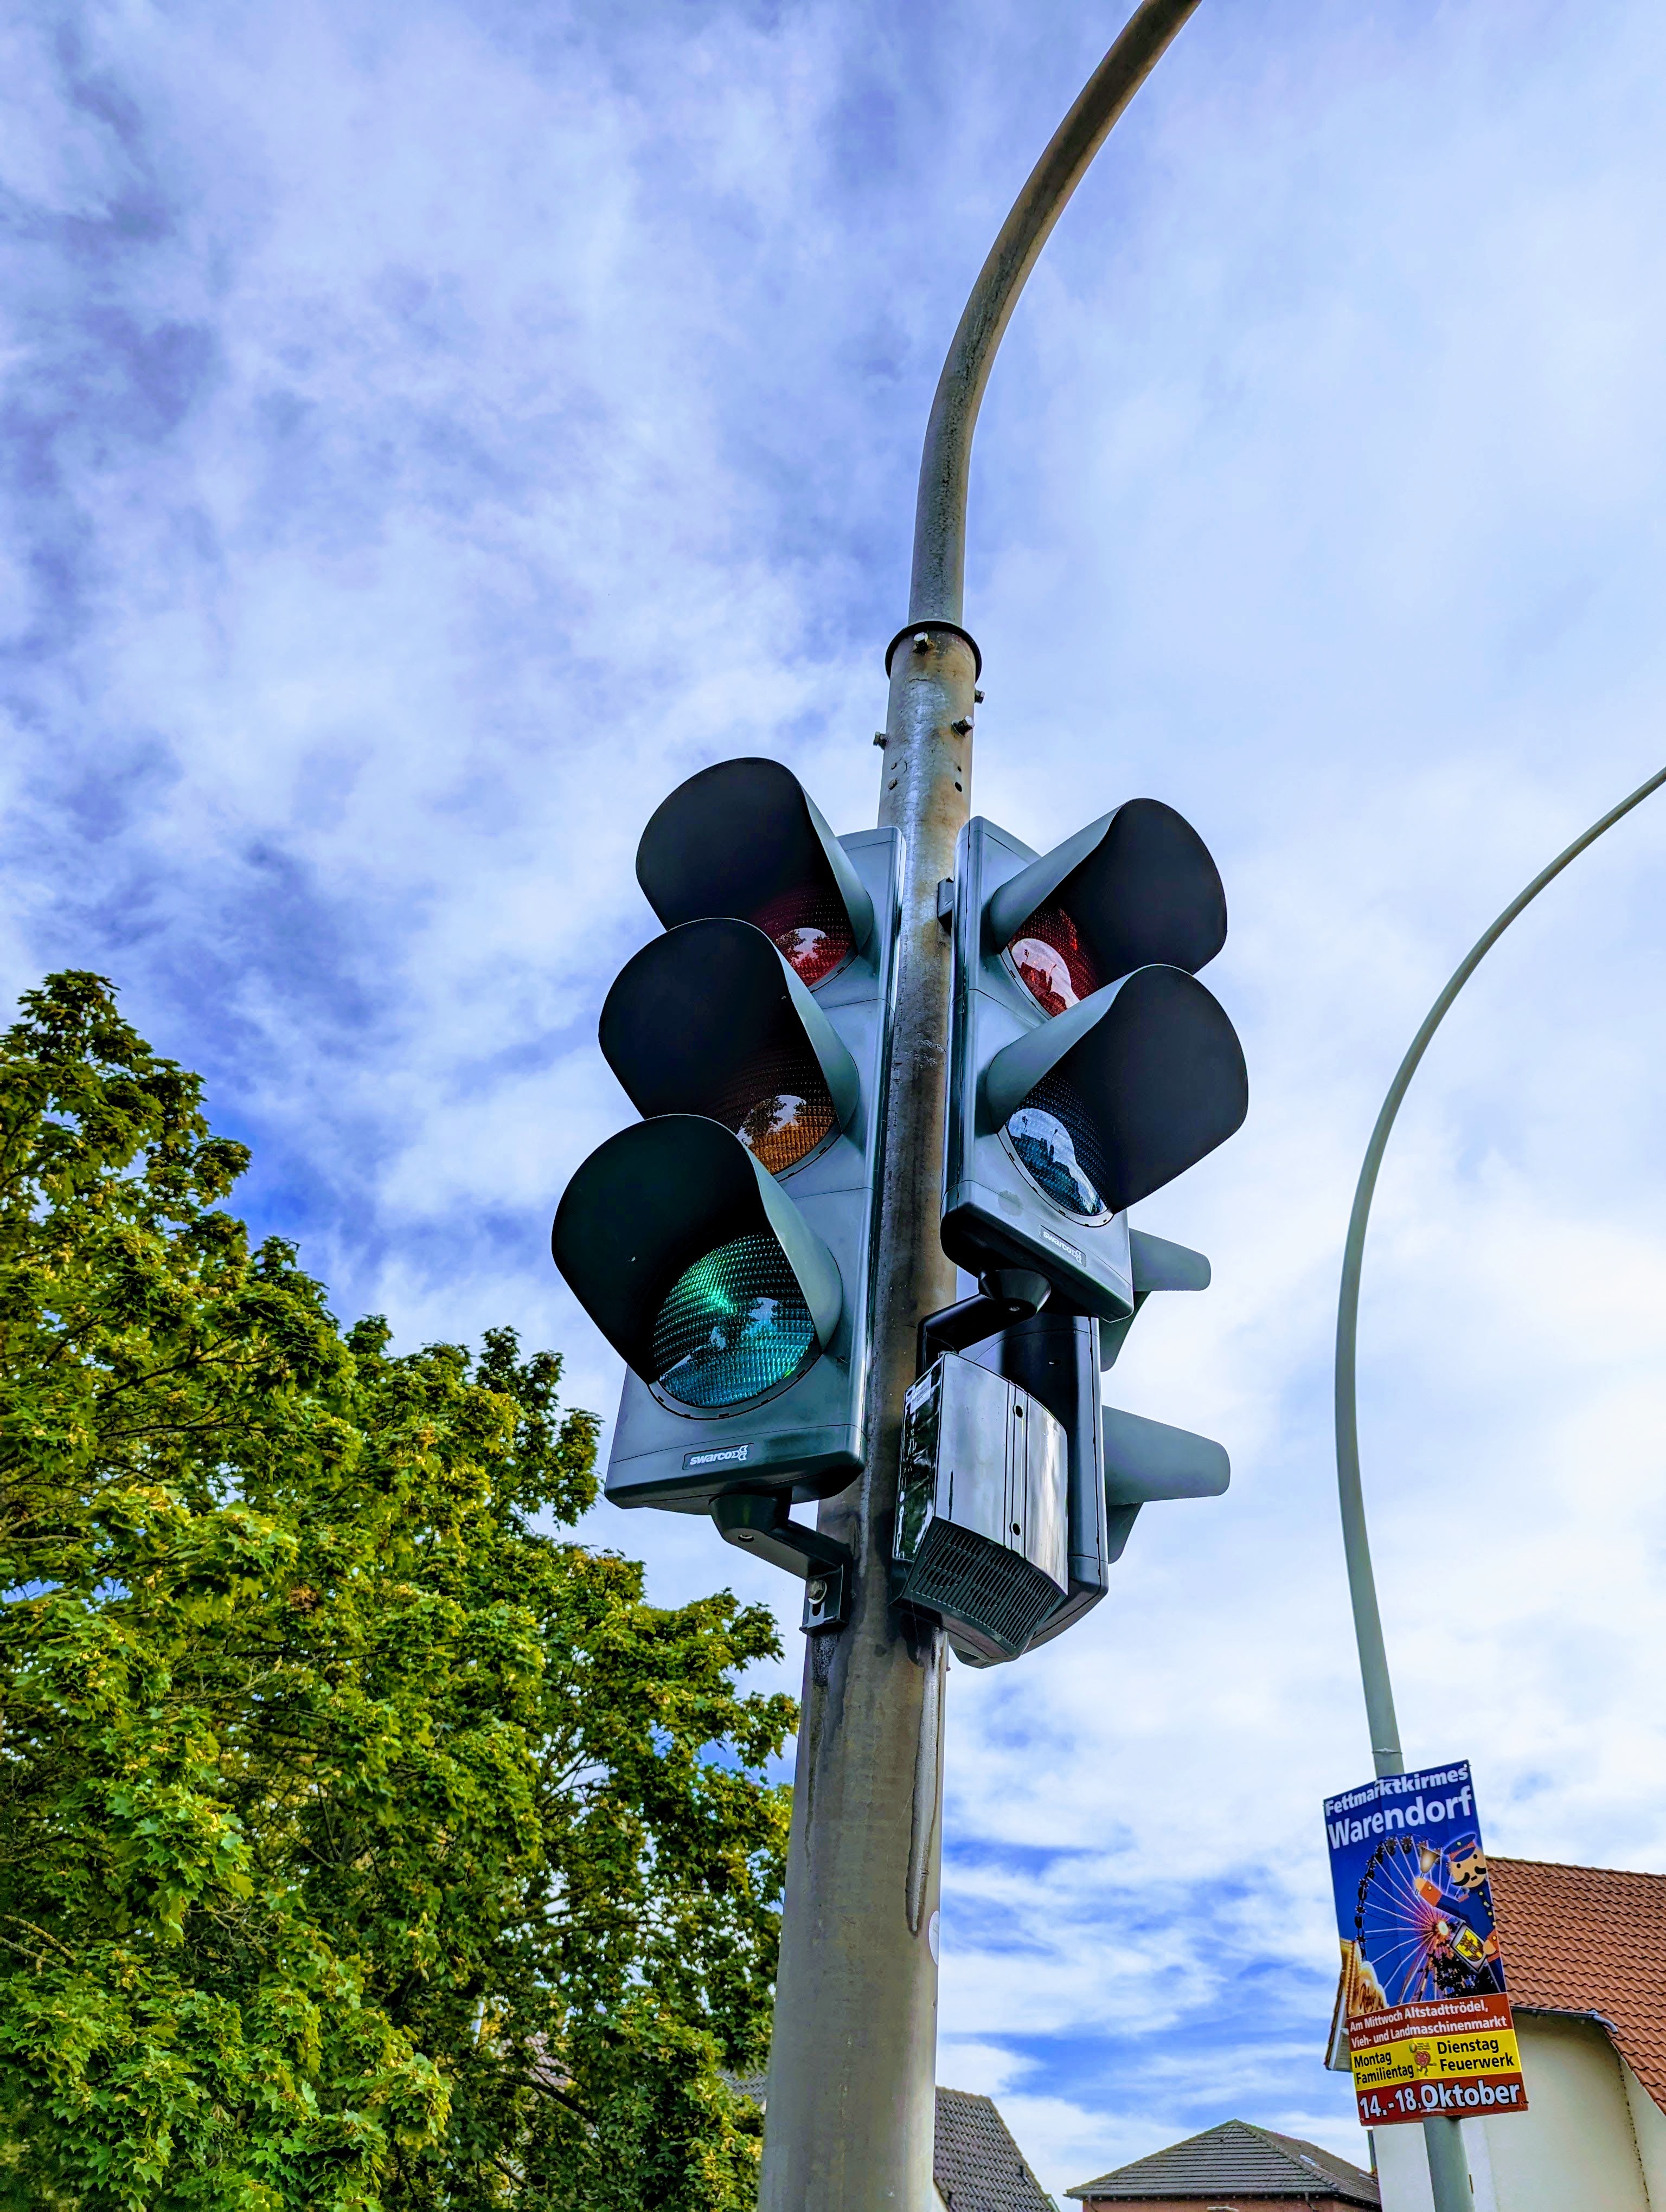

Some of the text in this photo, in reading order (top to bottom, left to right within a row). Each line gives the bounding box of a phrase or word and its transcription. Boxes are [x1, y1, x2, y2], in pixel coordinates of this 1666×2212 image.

[1043, 1231, 1073, 1255] swarco
[689, 1451, 732, 1465] swarco
[1325, 1765, 1469, 1817] Fettmarktkirmes
[1328, 1785, 1472, 1849] Warendorf
[1349, 1999, 1489, 2033] Am Mittwoch Altstadttrödel,
[1351, 2016, 1508, 2049] Vieh- und Landmaschinenmarkt
[1437, 2039, 1499, 2055] Dienstag
[1354, 2051, 1392, 2069] Montag
[1440, 2052, 1515, 2072] Feuerwerk
[1356, 2063, 1415, 2085] Familientag
